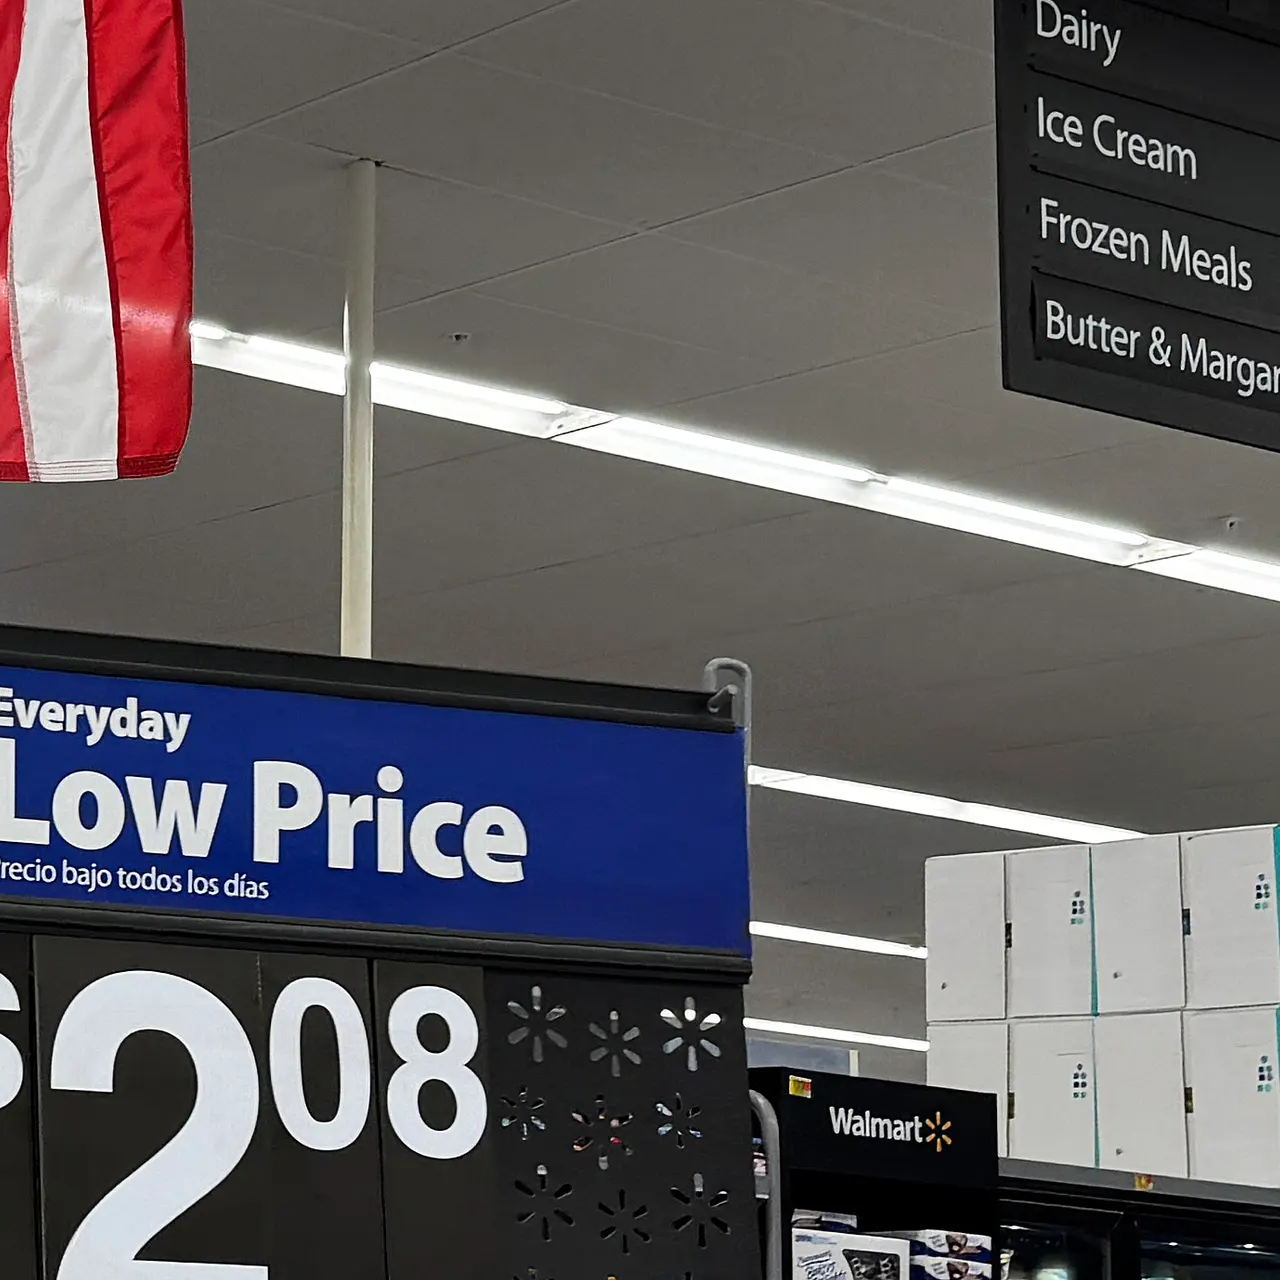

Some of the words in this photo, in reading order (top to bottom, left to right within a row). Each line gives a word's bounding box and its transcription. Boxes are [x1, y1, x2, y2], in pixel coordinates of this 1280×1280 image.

[1037, 96, 1084, 149] Ice
[1092, 113, 1198, 180] Cream
[1040, 197, 1150, 267] Frozen
[1161, 230, 1253, 293] Meals
[1046, 298, 1141, 359] Butter
[1148, 326, 1172, 368] &
[253, 760, 528, 883] Price
[62, 862, 113, 893] bajo
[116, 866, 183, 894] todos
[187, 868, 219, 895] los
[224, 870, 270, 899] días
[829, 1106, 923, 1143] Walmart
